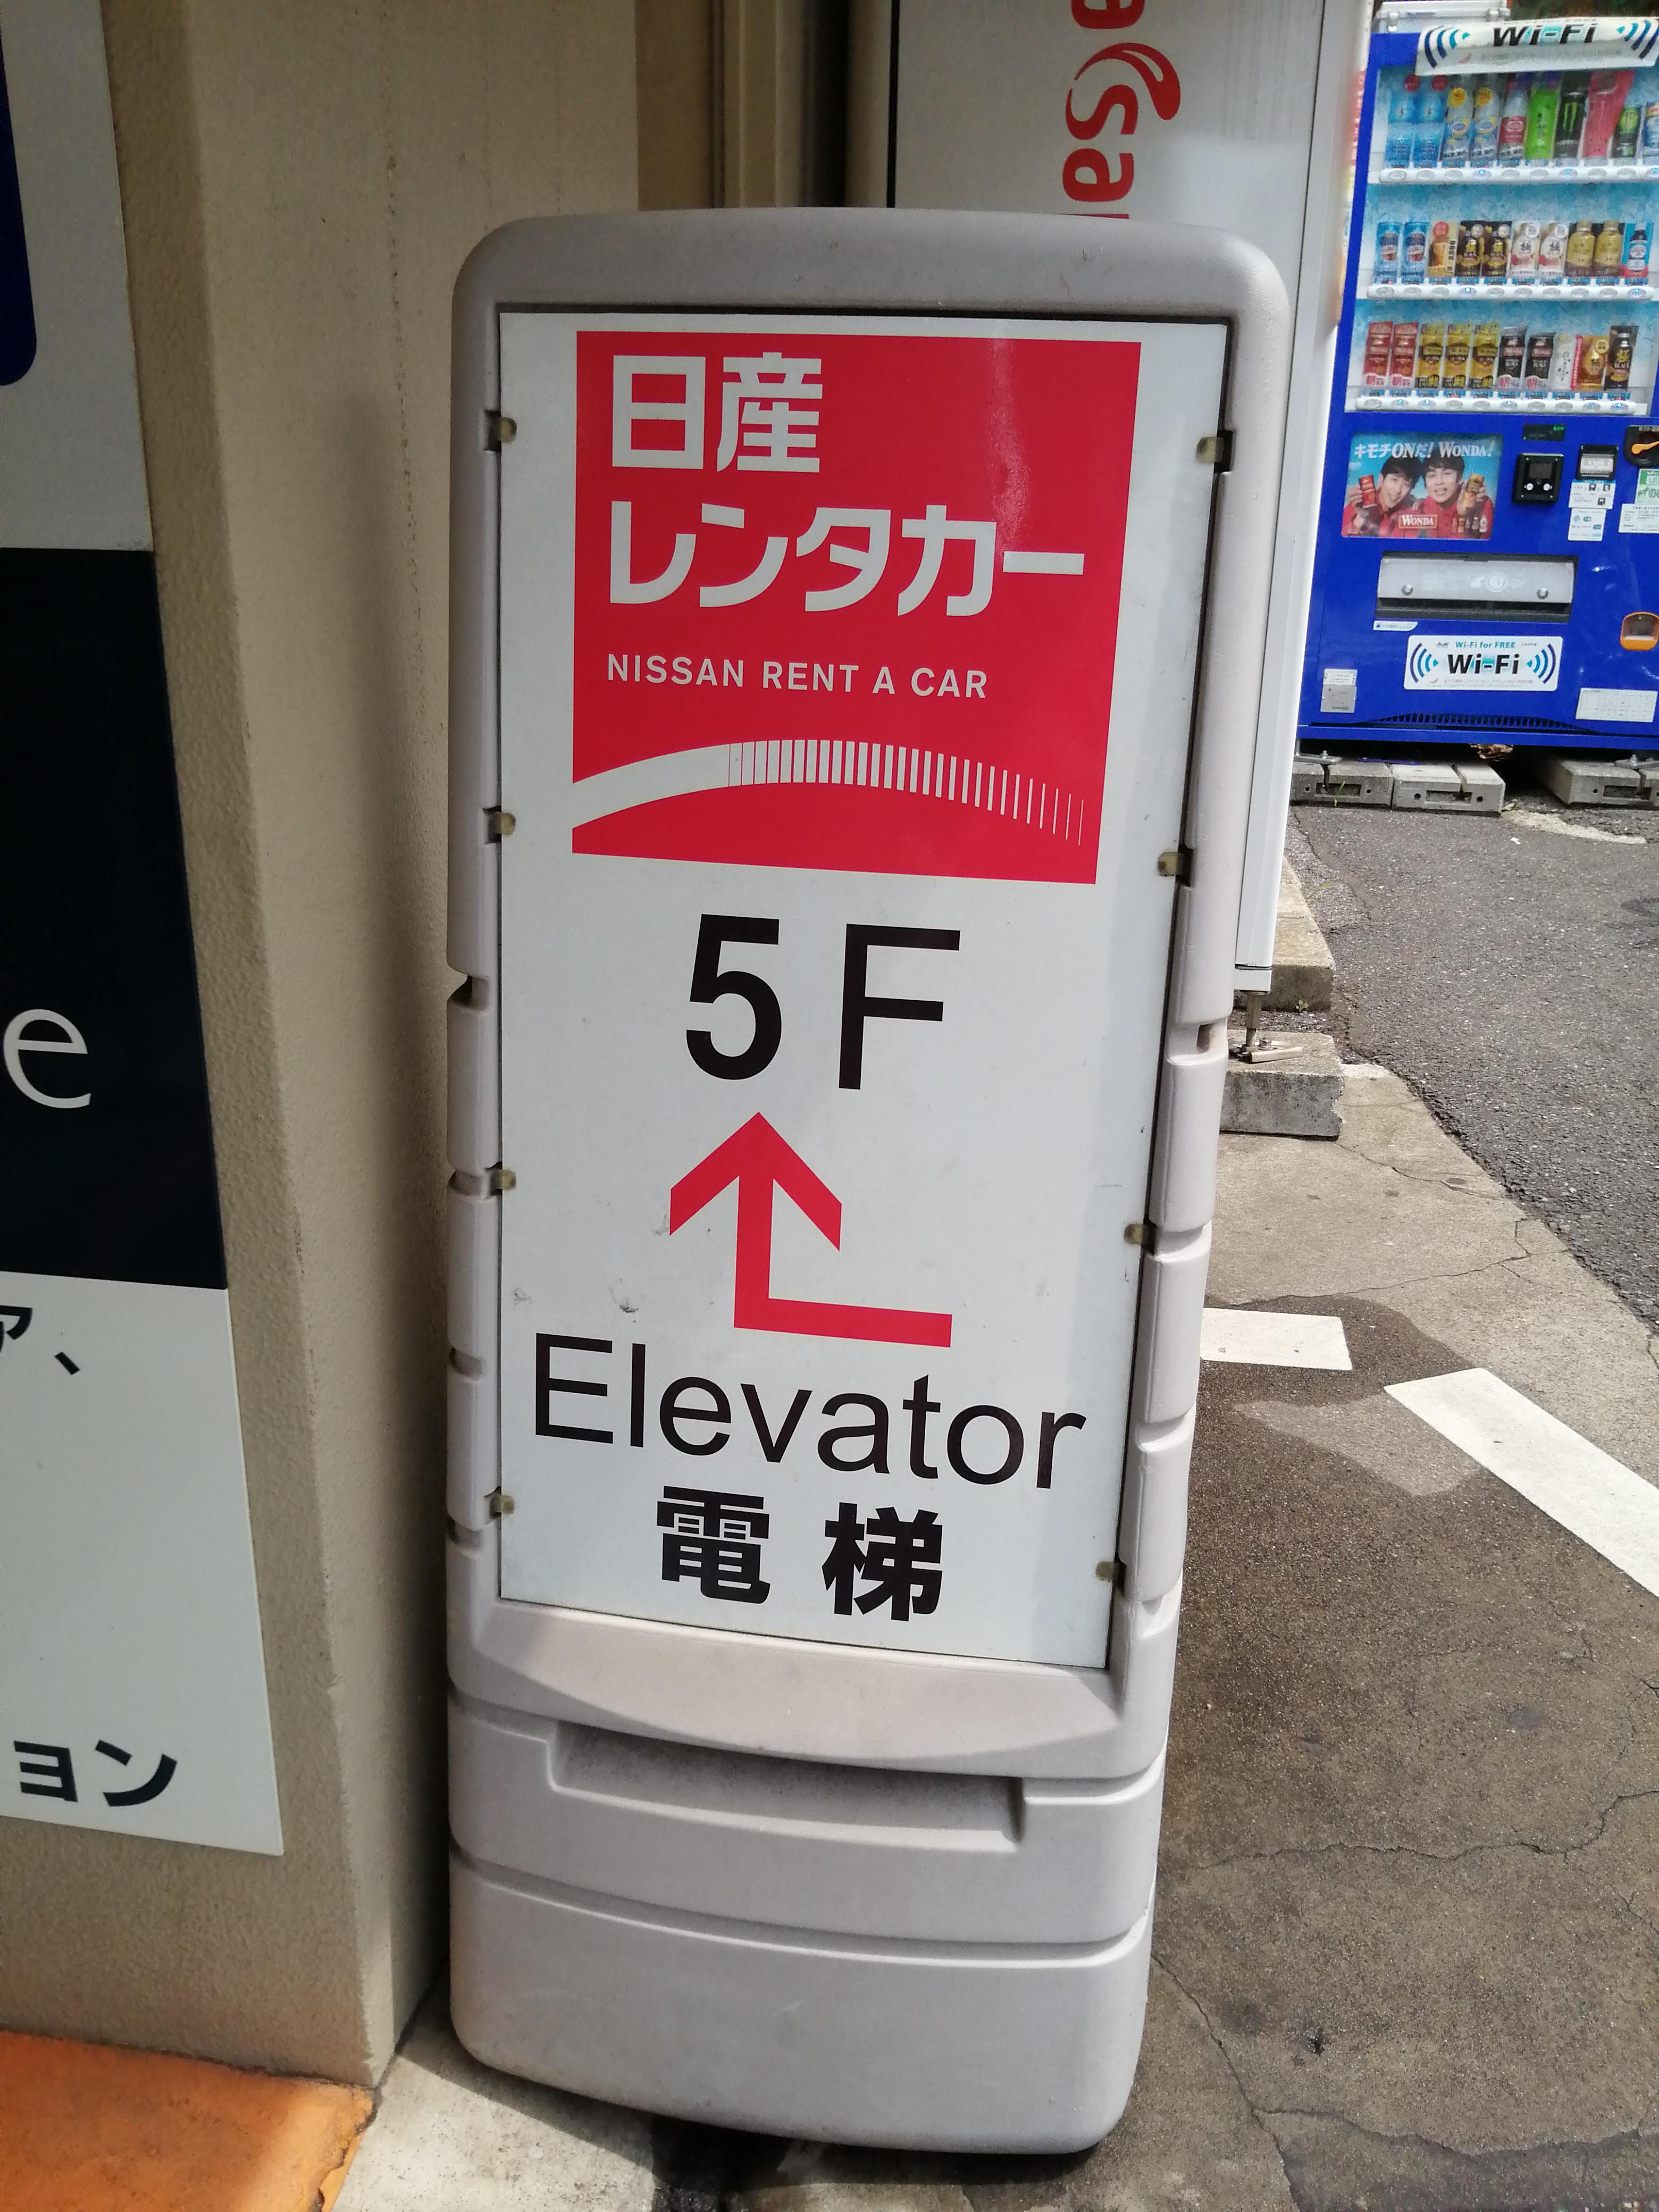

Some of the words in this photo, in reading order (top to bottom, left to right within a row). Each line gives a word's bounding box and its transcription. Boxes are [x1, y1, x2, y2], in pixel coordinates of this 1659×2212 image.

[1493, 23, 1598, 47] Wi-Fi
[613, 352, 822, 473] 日産
[1402, 515, 1434, 525] WONDA
[610, 501, 1085, 616] レンタカー
[608, 653, 744, 687] NISSAN
[763, 661, 859, 692] RENT
[873, 667, 895, 694] A
[911, 667, 986, 698] CAR
[1447, 653, 1520, 674] Wi-Fi
[535, 1333, 1086, 1489] Elevator
